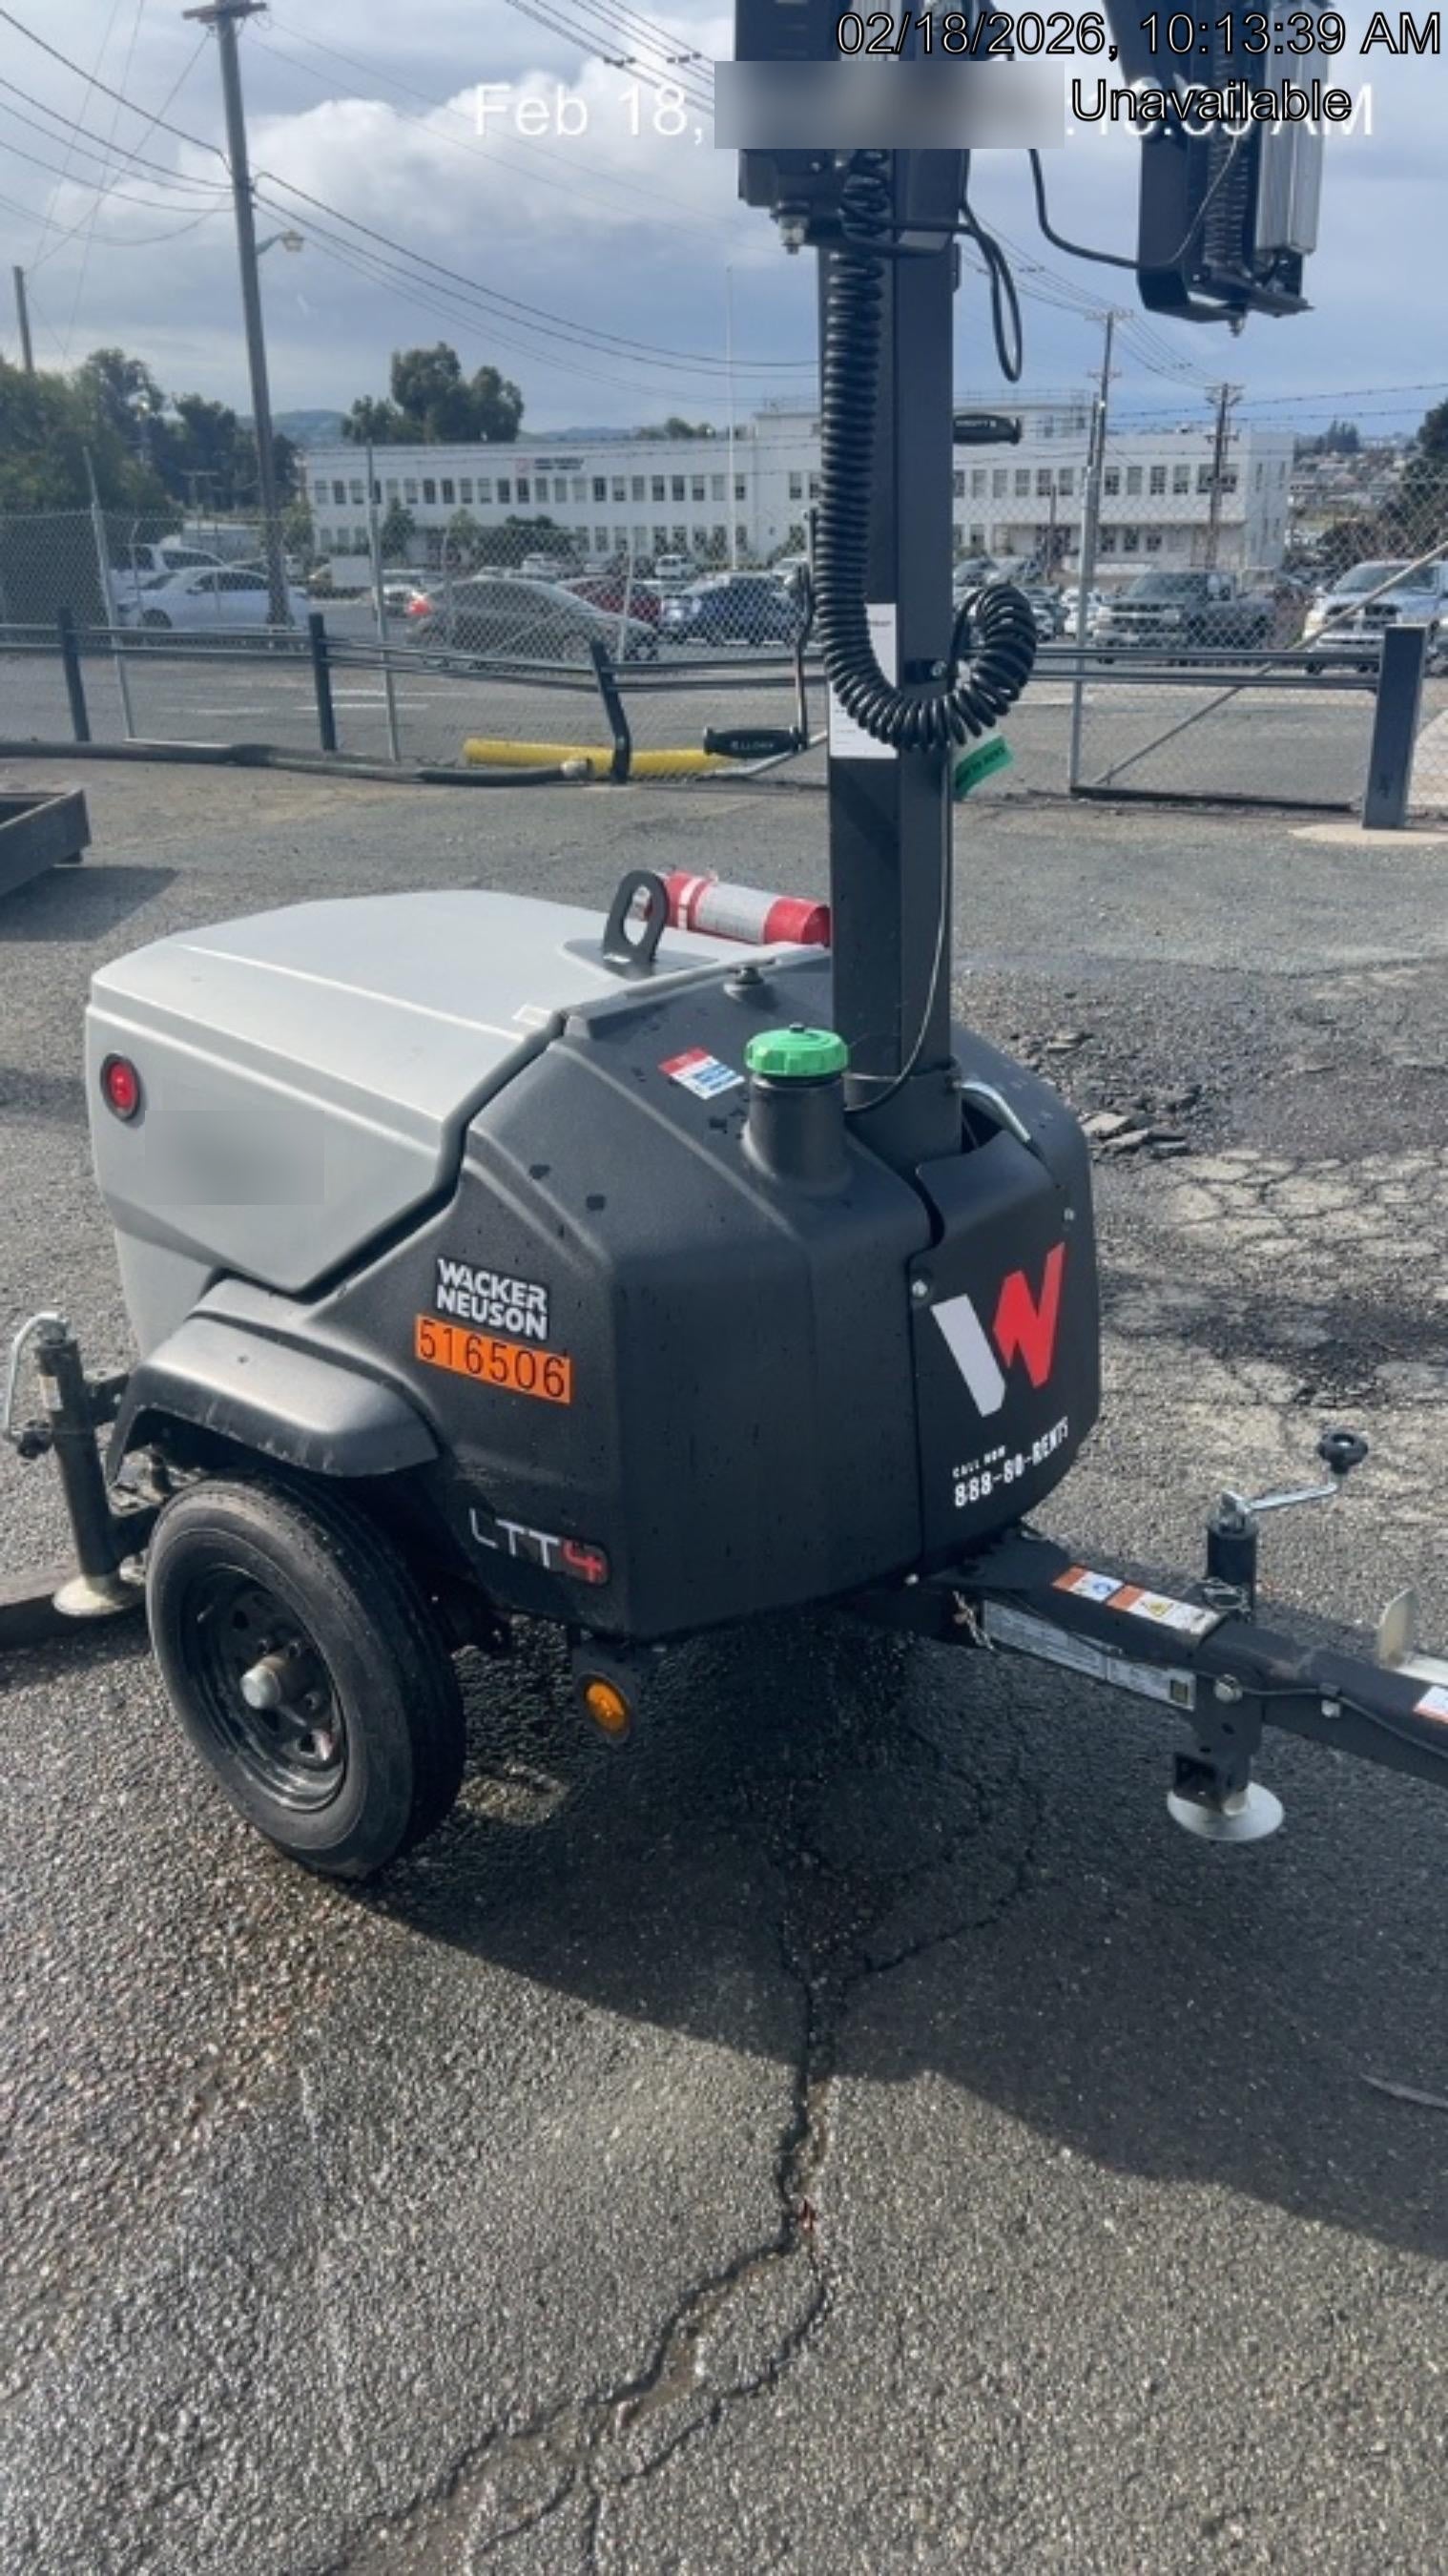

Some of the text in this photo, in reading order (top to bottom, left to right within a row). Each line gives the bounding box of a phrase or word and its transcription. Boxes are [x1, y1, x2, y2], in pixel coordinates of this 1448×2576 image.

[437, 1257, 548, 1314] WACKER
[437, 1284, 548, 1340] NEUSON
[420, 1319, 565, 1399] 516506
[468, 1507, 603, 1584] LTT4
